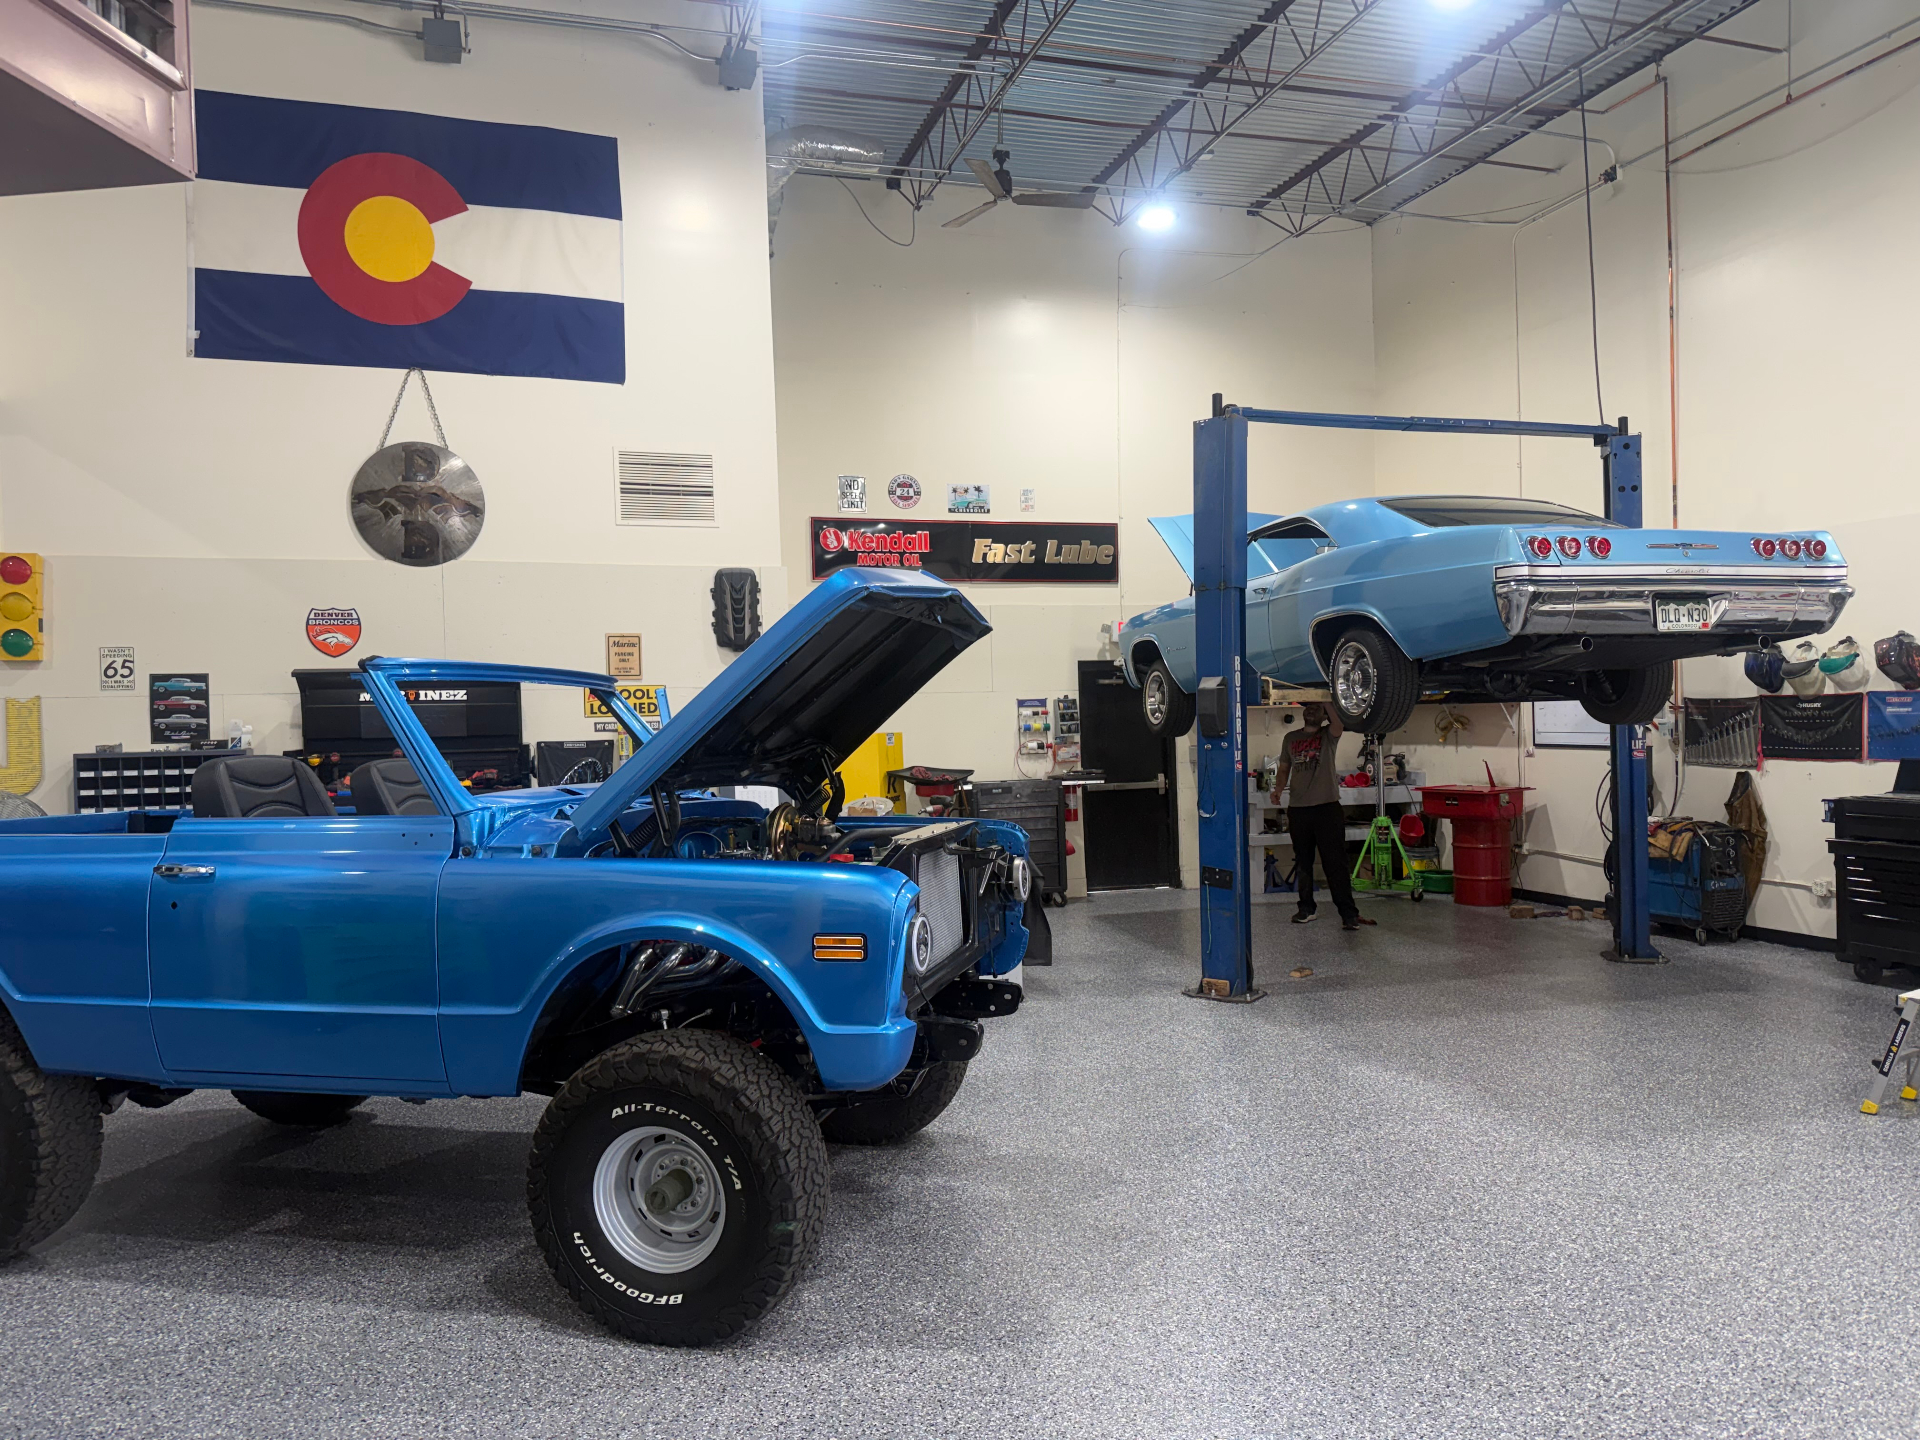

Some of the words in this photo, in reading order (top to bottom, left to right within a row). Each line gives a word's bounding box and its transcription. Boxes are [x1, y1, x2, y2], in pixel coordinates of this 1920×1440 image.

[845, 479, 860, 490] NO
[899, 488, 910, 496] 24
[841, 491, 864, 500] SPEED
[841, 500, 864, 509] LIMIT
[847, 530, 930, 552] Kendall
[857, 553, 900, 566] MOTOR
[903, 553, 922, 566] OIL
[971, 538, 1037, 564] Fast
[1044, 539, 1114, 565] Lube
[610, 639, 638, 648] Marine
[103, 659, 134, 679] 65
[1234, 655, 1242, 749] ROTARY
[610, 1102, 719, 1147] All-Terrain
[723, 1154, 743, 1191] T/A
[572, 1231, 684, 1306] BFGoodrich
